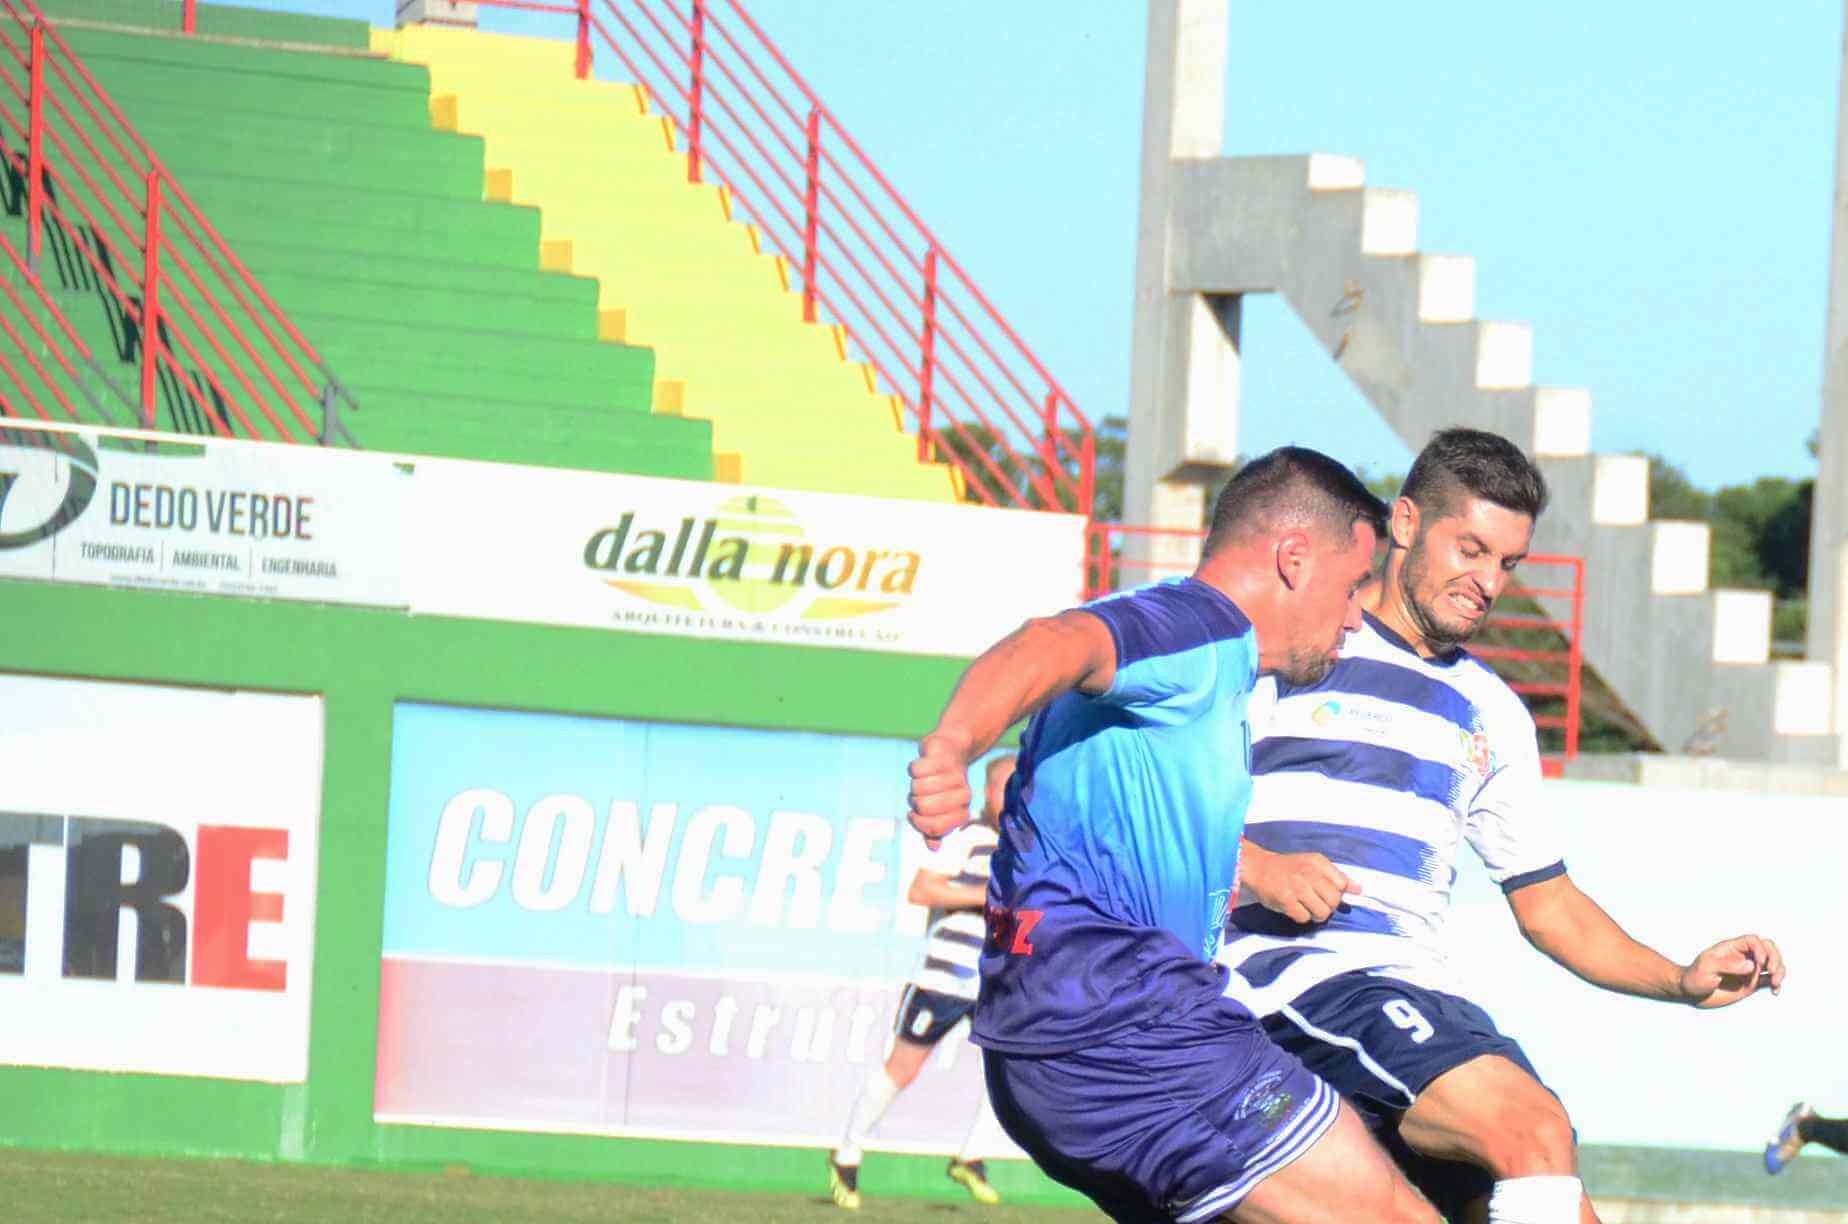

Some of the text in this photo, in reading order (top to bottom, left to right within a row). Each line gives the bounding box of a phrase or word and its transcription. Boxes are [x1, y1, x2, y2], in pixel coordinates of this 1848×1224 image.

[110, 482, 315, 541] DEDO VERDE
[80, 541, 155, 565] TOPOGRAFIA
[172, 548, 241, 572] AMBIENTAL
[583, 512, 923, 596] dalla nora
[1381, 999, 1435, 1046] 9
